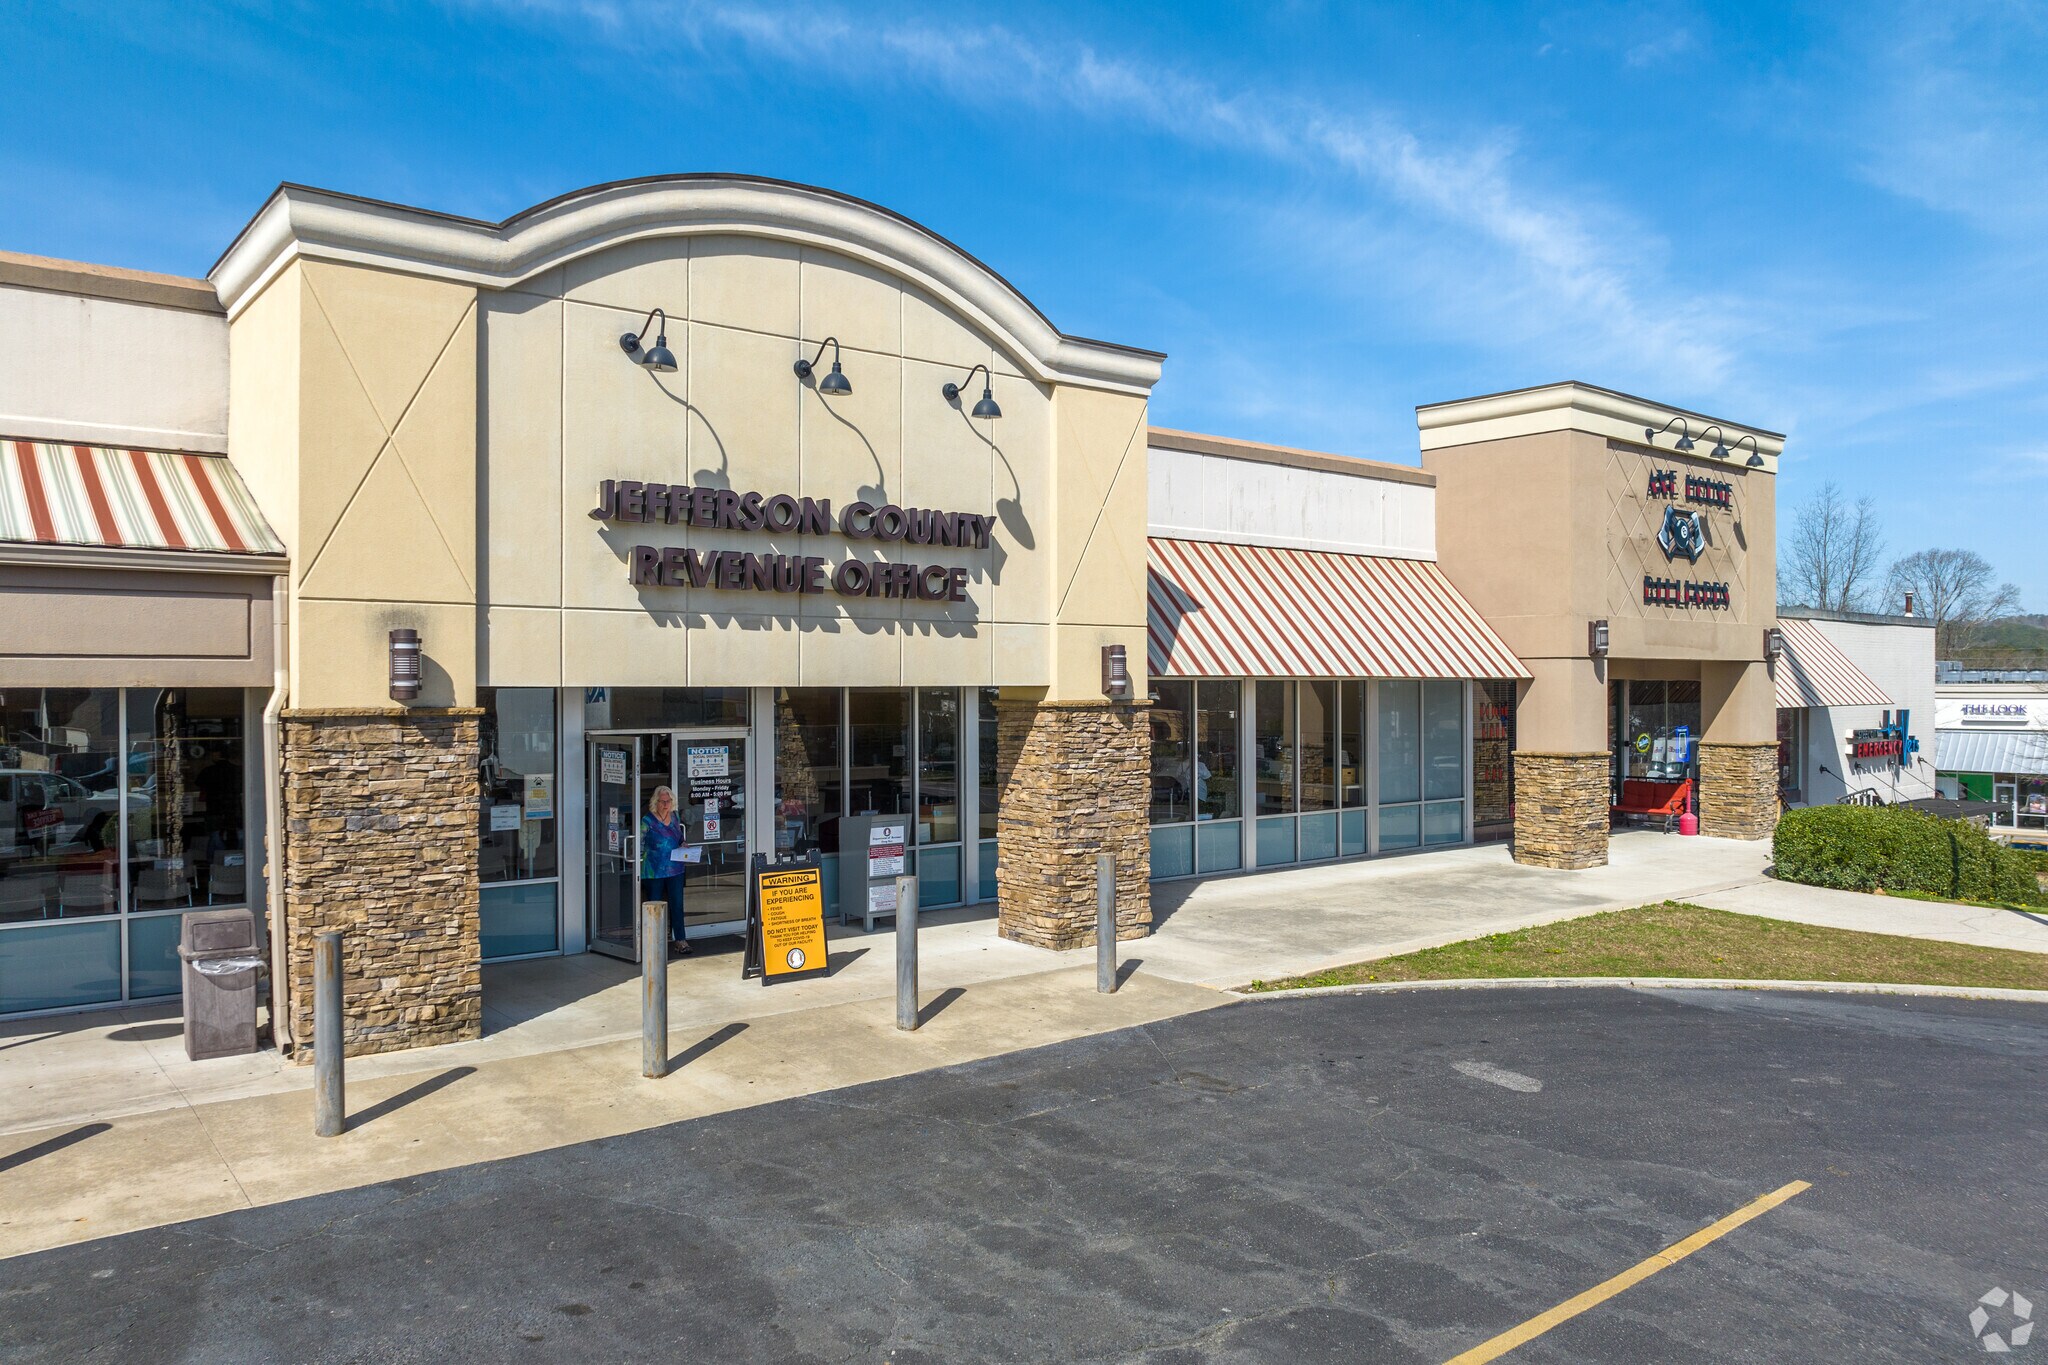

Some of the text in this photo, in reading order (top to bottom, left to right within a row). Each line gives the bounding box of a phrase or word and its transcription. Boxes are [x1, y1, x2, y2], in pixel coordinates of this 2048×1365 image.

[588, 479, 997, 549] JEFFERSON COUNTY
[629, 546, 967, 602] REVENUE OFFICE
[1643, 576, 1730, 609] BILLIARDS
[1962, 703, 2028, 714] THE LOOK
[1857, 740, 1902, 758] EMERGENCY
[769, 875, 810, 885] WARNING
[779, 888, 792, 896] YOU
[766, 894, 814, 905] EXPERIENCING
